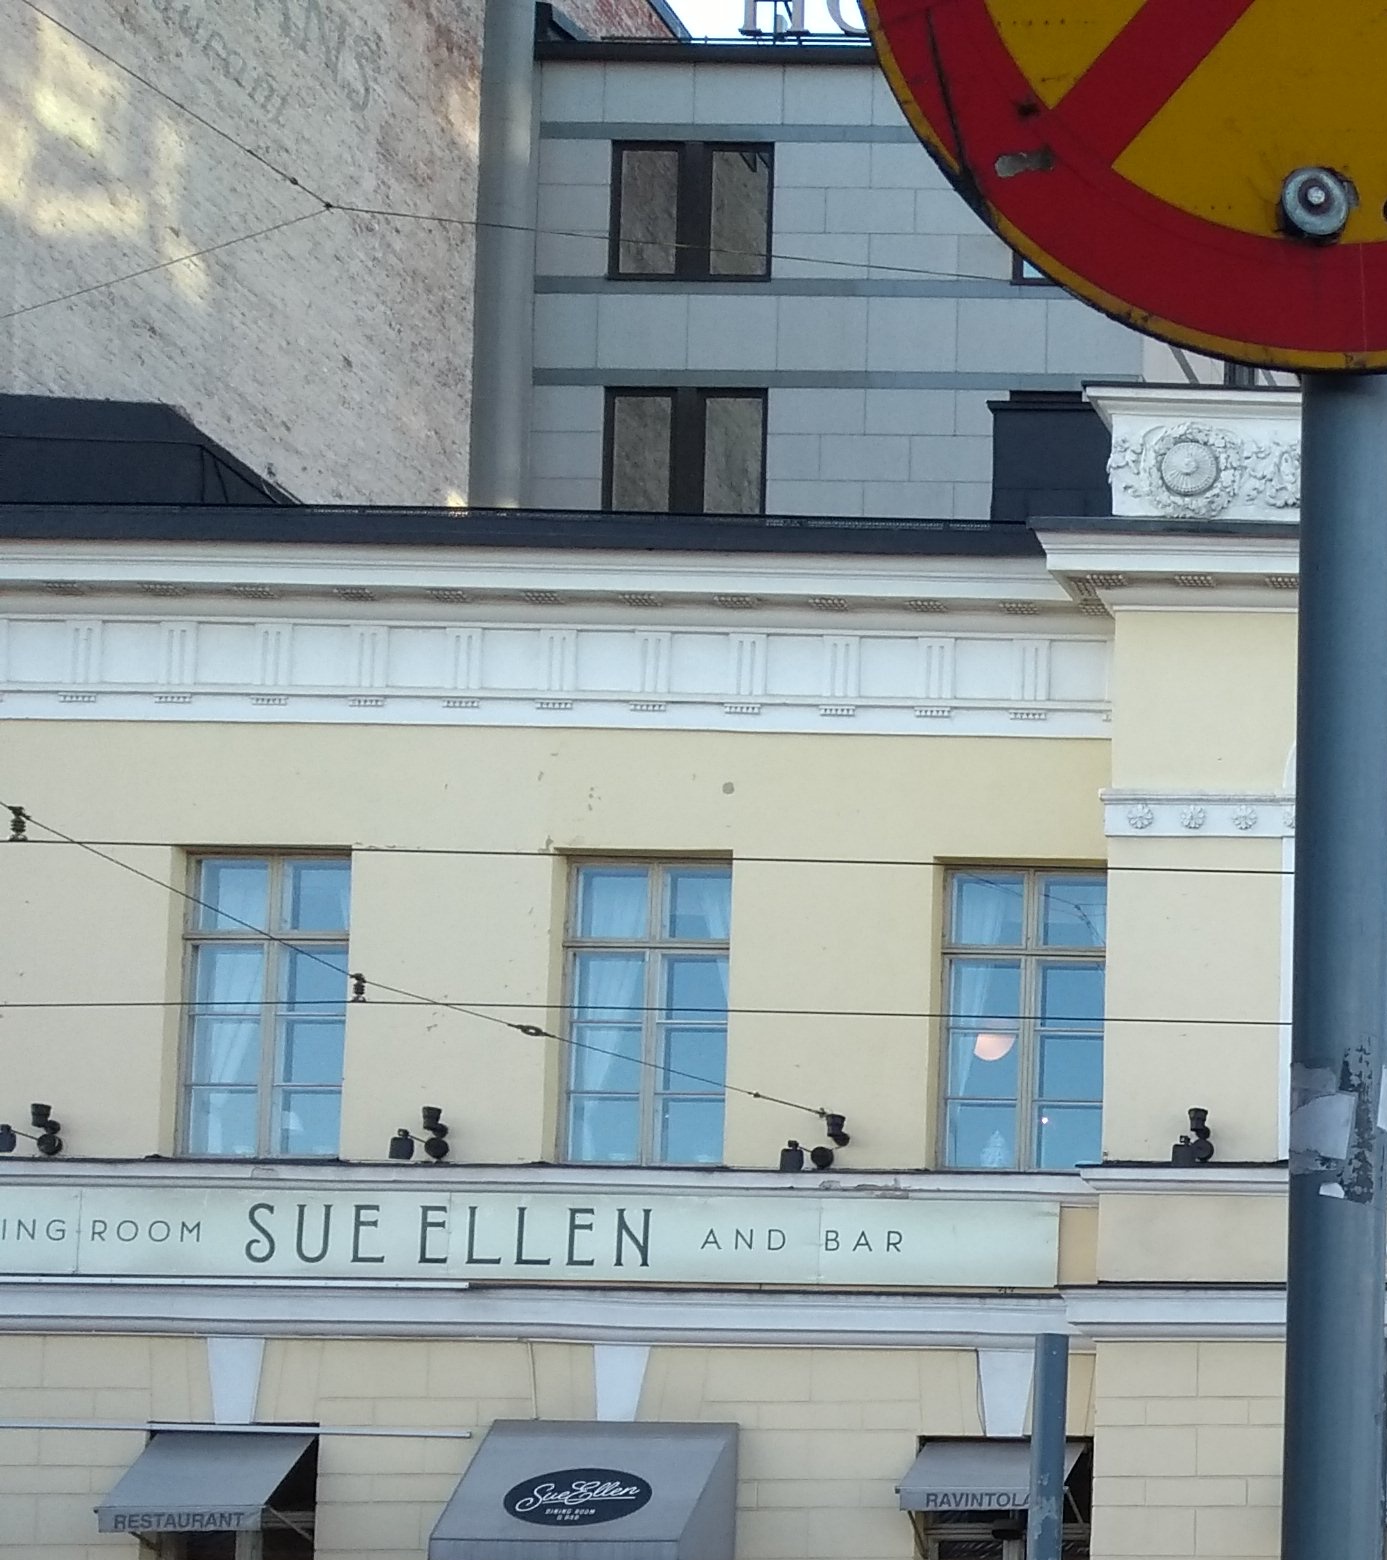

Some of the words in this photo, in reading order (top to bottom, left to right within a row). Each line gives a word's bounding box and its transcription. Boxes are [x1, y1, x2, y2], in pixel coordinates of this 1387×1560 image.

[90, 1219, 201, 1242] ROOM
[244, 1202, 385, 1264] SUE
[417, 1204, 653, 1267] ELLEN
[700, 1228, 786, 1251] AND
[825, 1229, 903, 1252] BAR
[114, 1512, 245, 1530] RESTAURANT
